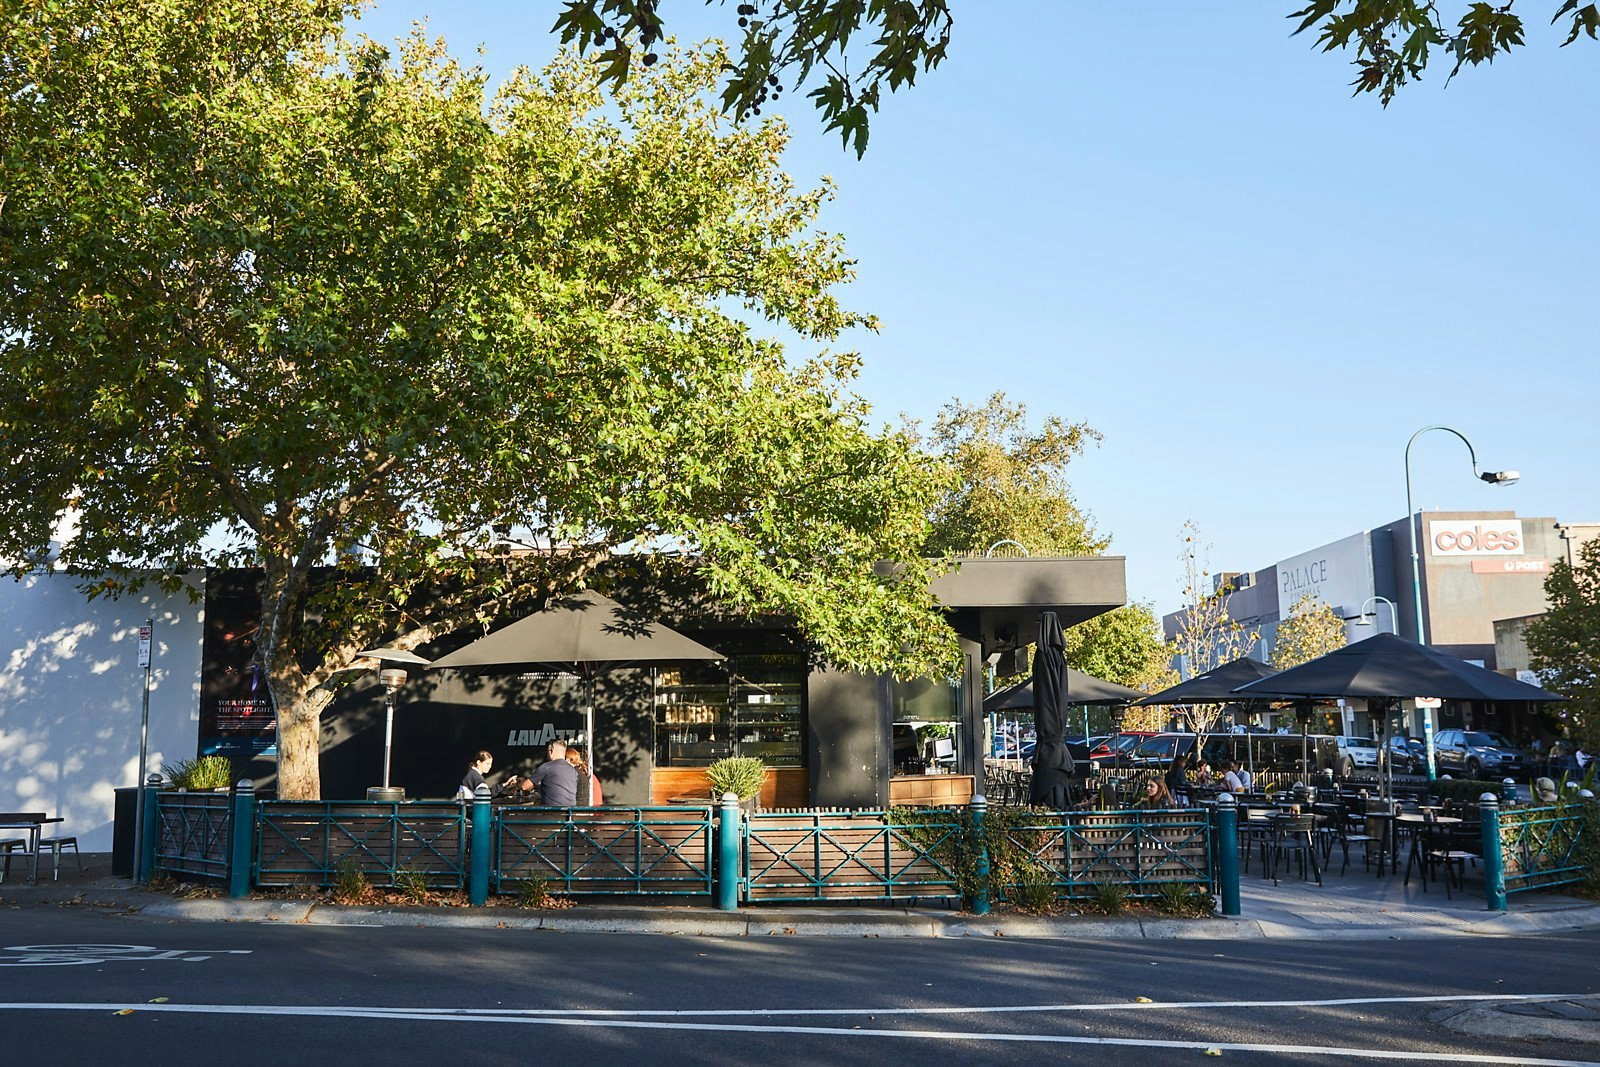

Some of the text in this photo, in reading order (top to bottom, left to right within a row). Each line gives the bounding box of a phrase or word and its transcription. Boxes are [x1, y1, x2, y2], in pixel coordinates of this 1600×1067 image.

[1435, 526, 1520, 551] coles
[1282, 559, 1327, 592] PALACE
[1516, 561, 1545, 571] POST
